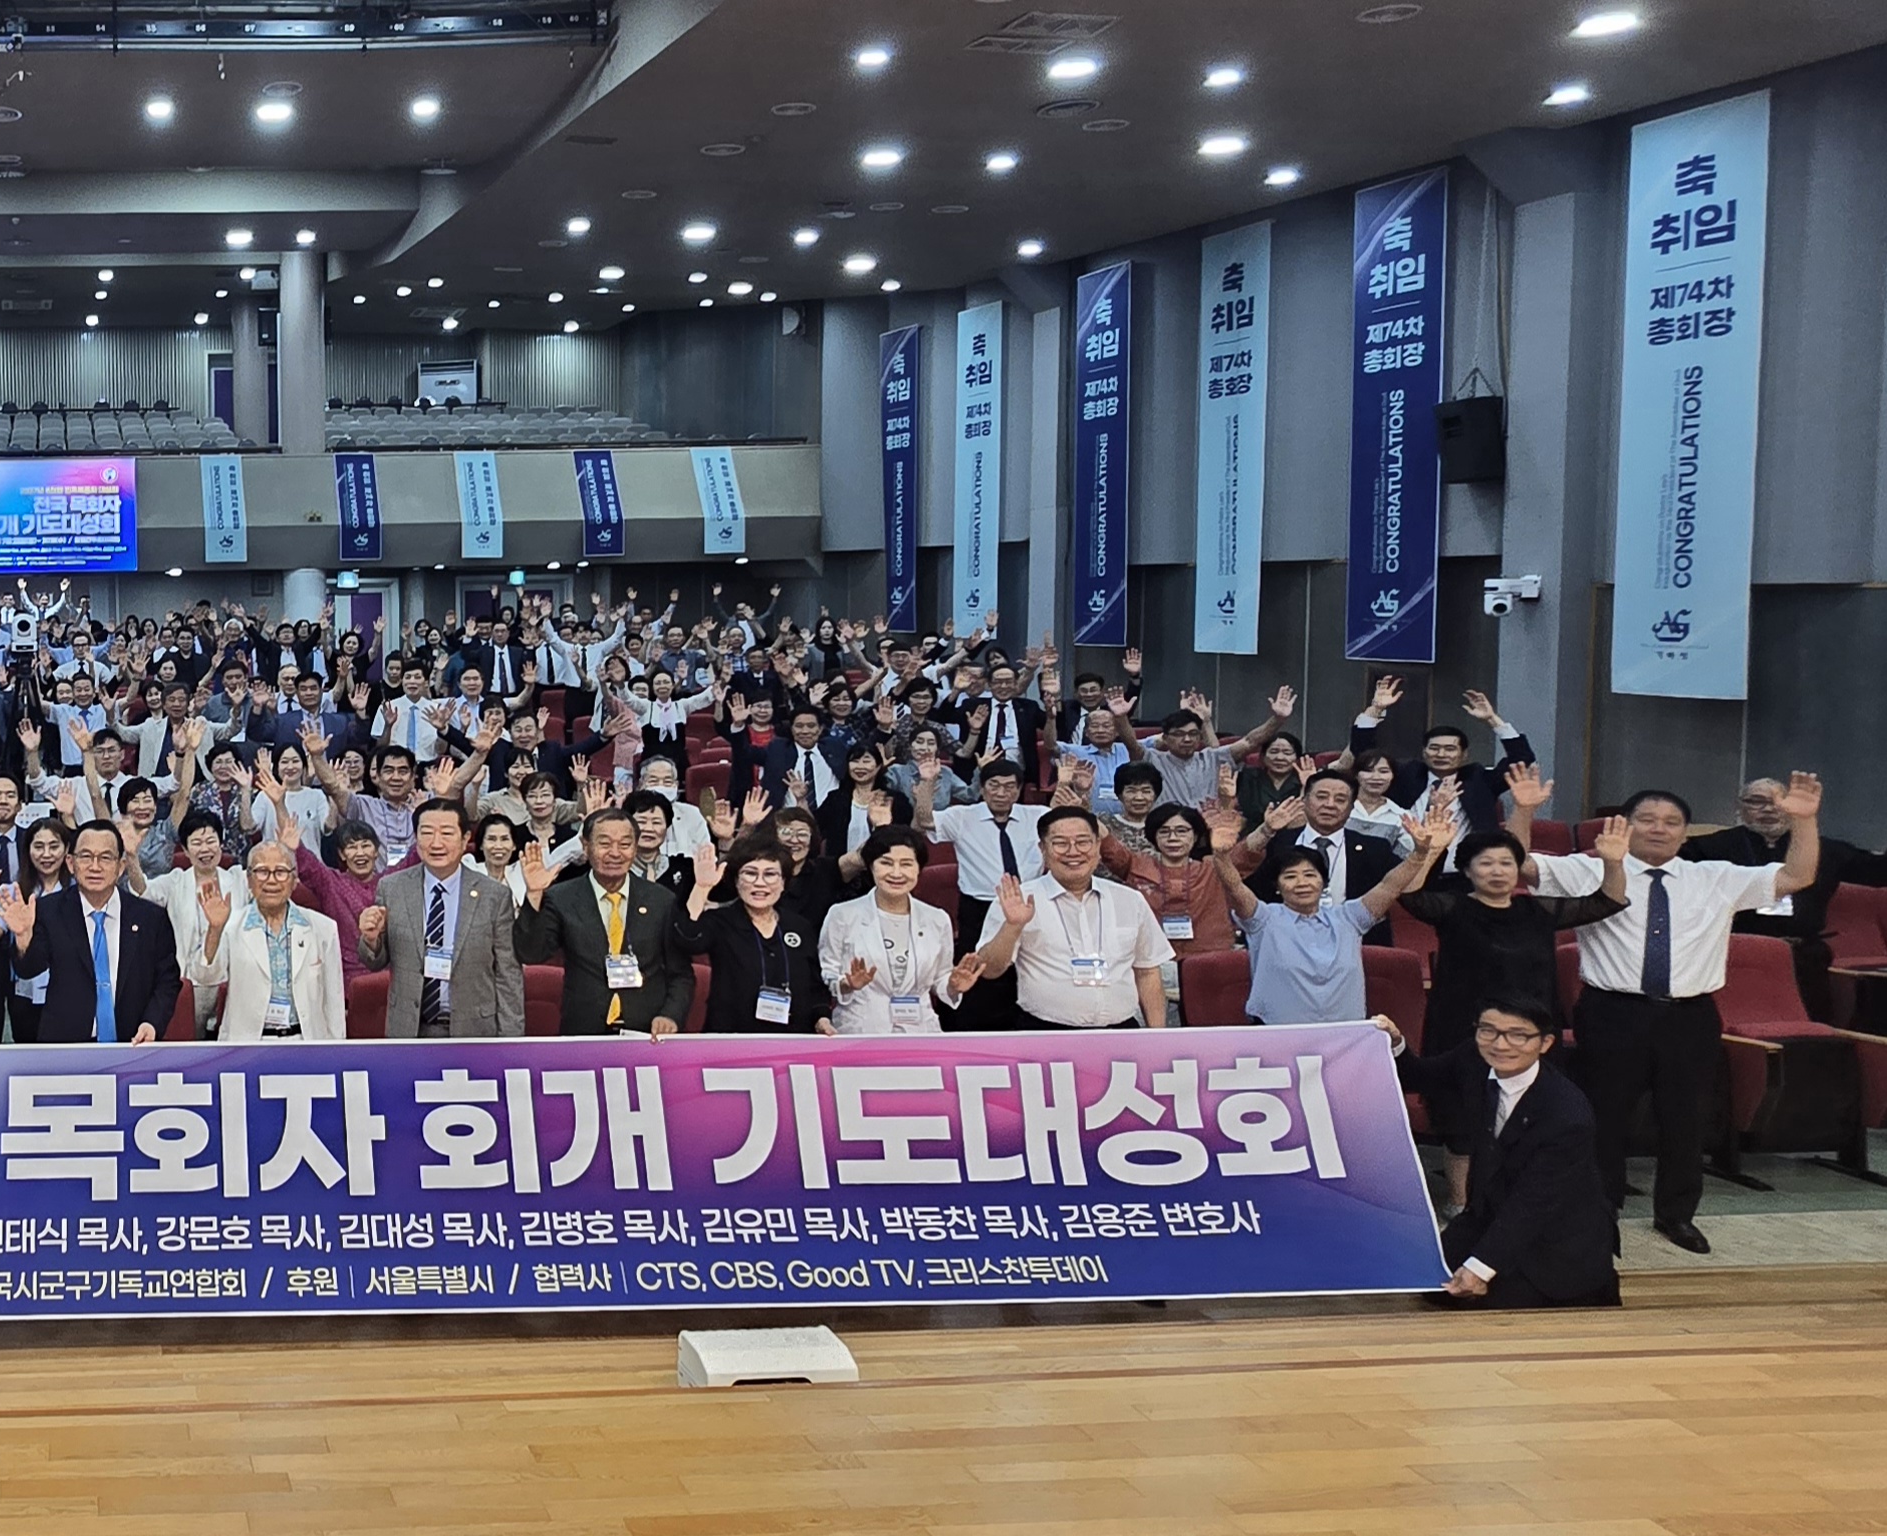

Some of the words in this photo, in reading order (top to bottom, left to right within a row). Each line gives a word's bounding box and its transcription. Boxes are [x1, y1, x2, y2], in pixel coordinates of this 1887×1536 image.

[1674, 154, 1716, 198] 축
[1381, 216, 1414, 254] 축
[1650, 199, 1738, 255] 취임
[1222, 262, 1244, 293] 축
[1368, 253, 1427, 300] 취임
[1649, 274, 1734, 314] 제74차
[1096, 298, 1112, 326] 축
[1211, 296, 1254, 334] 취임
[1365, 313, 1425, 347] 제74차
[1647, 308, 1736, 347] 총회장
[973, 333, 986, 357] 축
[1086, 328, 1120, 362] 취임
[1362, 342, 1425, 374] 총회장
[887, 377, 910, 403] 취임
[965, 360, 992, 388] 취임
[1084, 376, 1118, 397] 제74차
[1083, 396, 1119, 420] 총회장
[1385, 388, 1405, 573] CONGRATULATIONS
[1672, 365, 1703, 589] CONGRATULATIONS
[33, 496, 68, 513] 전국
[70, 495, 121, 513] 목회자
[894, 462, 904, 577] CONGRATULATIONS
[972, 451, 984, 577] CONGRATULATIONS
[1097, 433, 1110, 577] CONGRATULATIONS
[23, 513, 120, 535] 기도대성회
[0, 1070, 386, 1202] 목회자
[414, 1064, 673, 1197] 회개
[704, 1054, 1347, 1191] 기도대성회
[78, 1217, 147, 1255] 목사,
[157, 1215, 253, 1251] 강문호
[261, 1215, 331, 1252] 목사,
[339, 1213, 434, 1248] 김대성
[443, 1212, 514, 1250] 목사,
[520, 1210, 618, 1245] 김병호
[624, 1209, 696, 1246] 목사,
[701, 1208, 799, 1243] 김유민
[804, 1207, 878, 1244] 목사,
[881, 1206, 979, 1241] 박동찬
[983, 1205, 1058, 1241] 목사,
[1059, 1204, 1159, 1237] 김용준
[1161, 1201, 1260, 1235] 변호사
[287, 1267, 339, 1297] 후원
[366, 1265, 493, 1295] 서울특별시
[532, 1263, 612, 1292] 협력사
[636, 1262, 706, 1292] CTS,
[710, 1261, 783, 1290] CBS,
[787, 1259, 870, 1287] Good
[871, 1259, 922, 1288] TV,
[924, 1255, 1108, 1285] 크리스찬투데이
